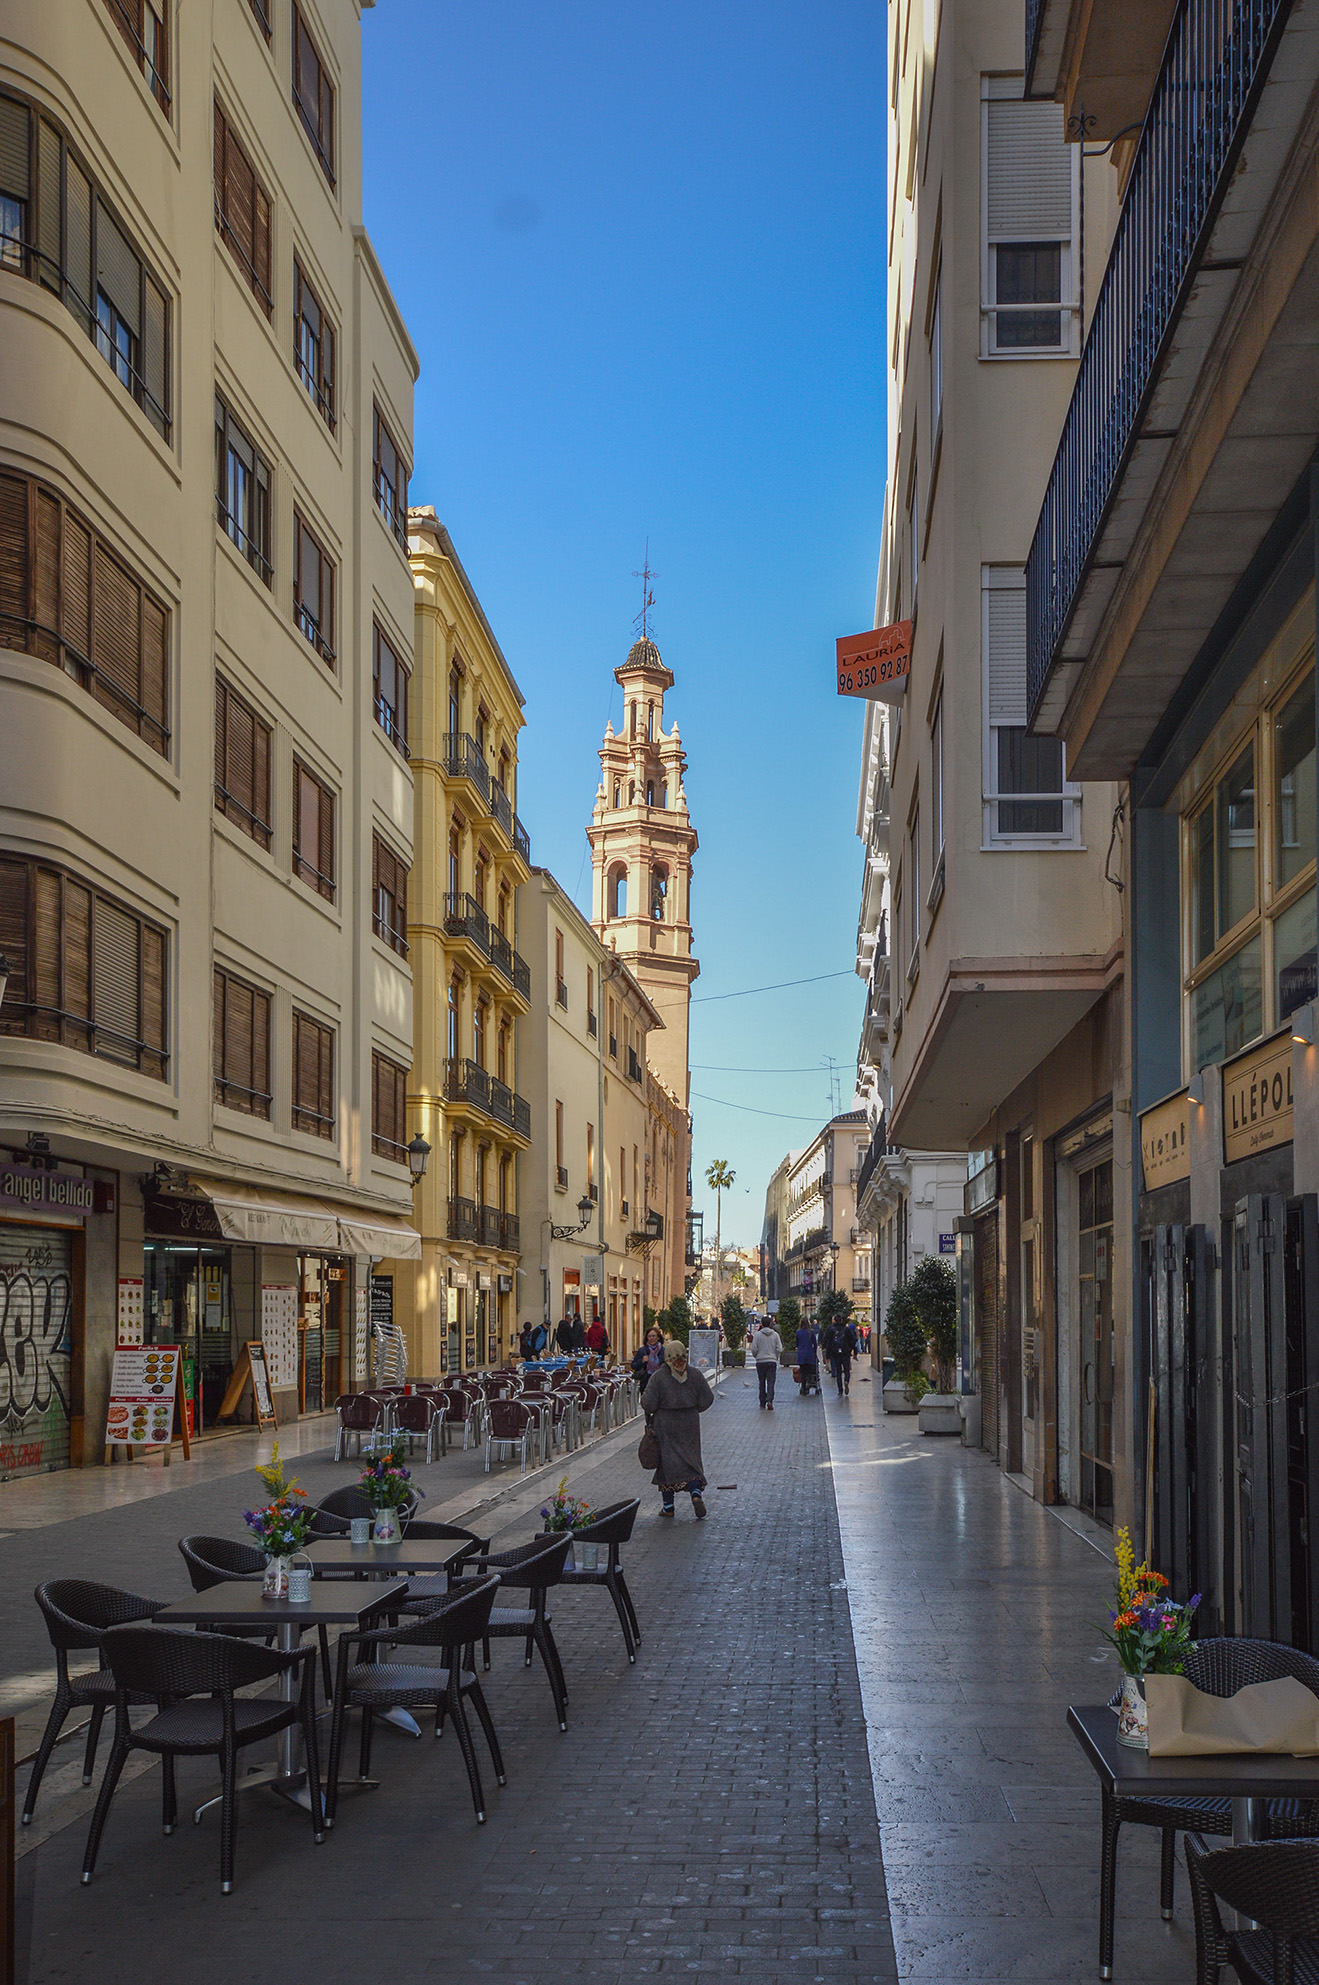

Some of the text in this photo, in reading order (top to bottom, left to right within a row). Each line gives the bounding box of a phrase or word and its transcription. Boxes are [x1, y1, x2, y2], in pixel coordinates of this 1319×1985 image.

[839, 654, 908, 692] 96 350 92 87
[1232, 1066, 1294, 1130] LLÉPOL
[4, 1172, 93, 1208] angel bellido
